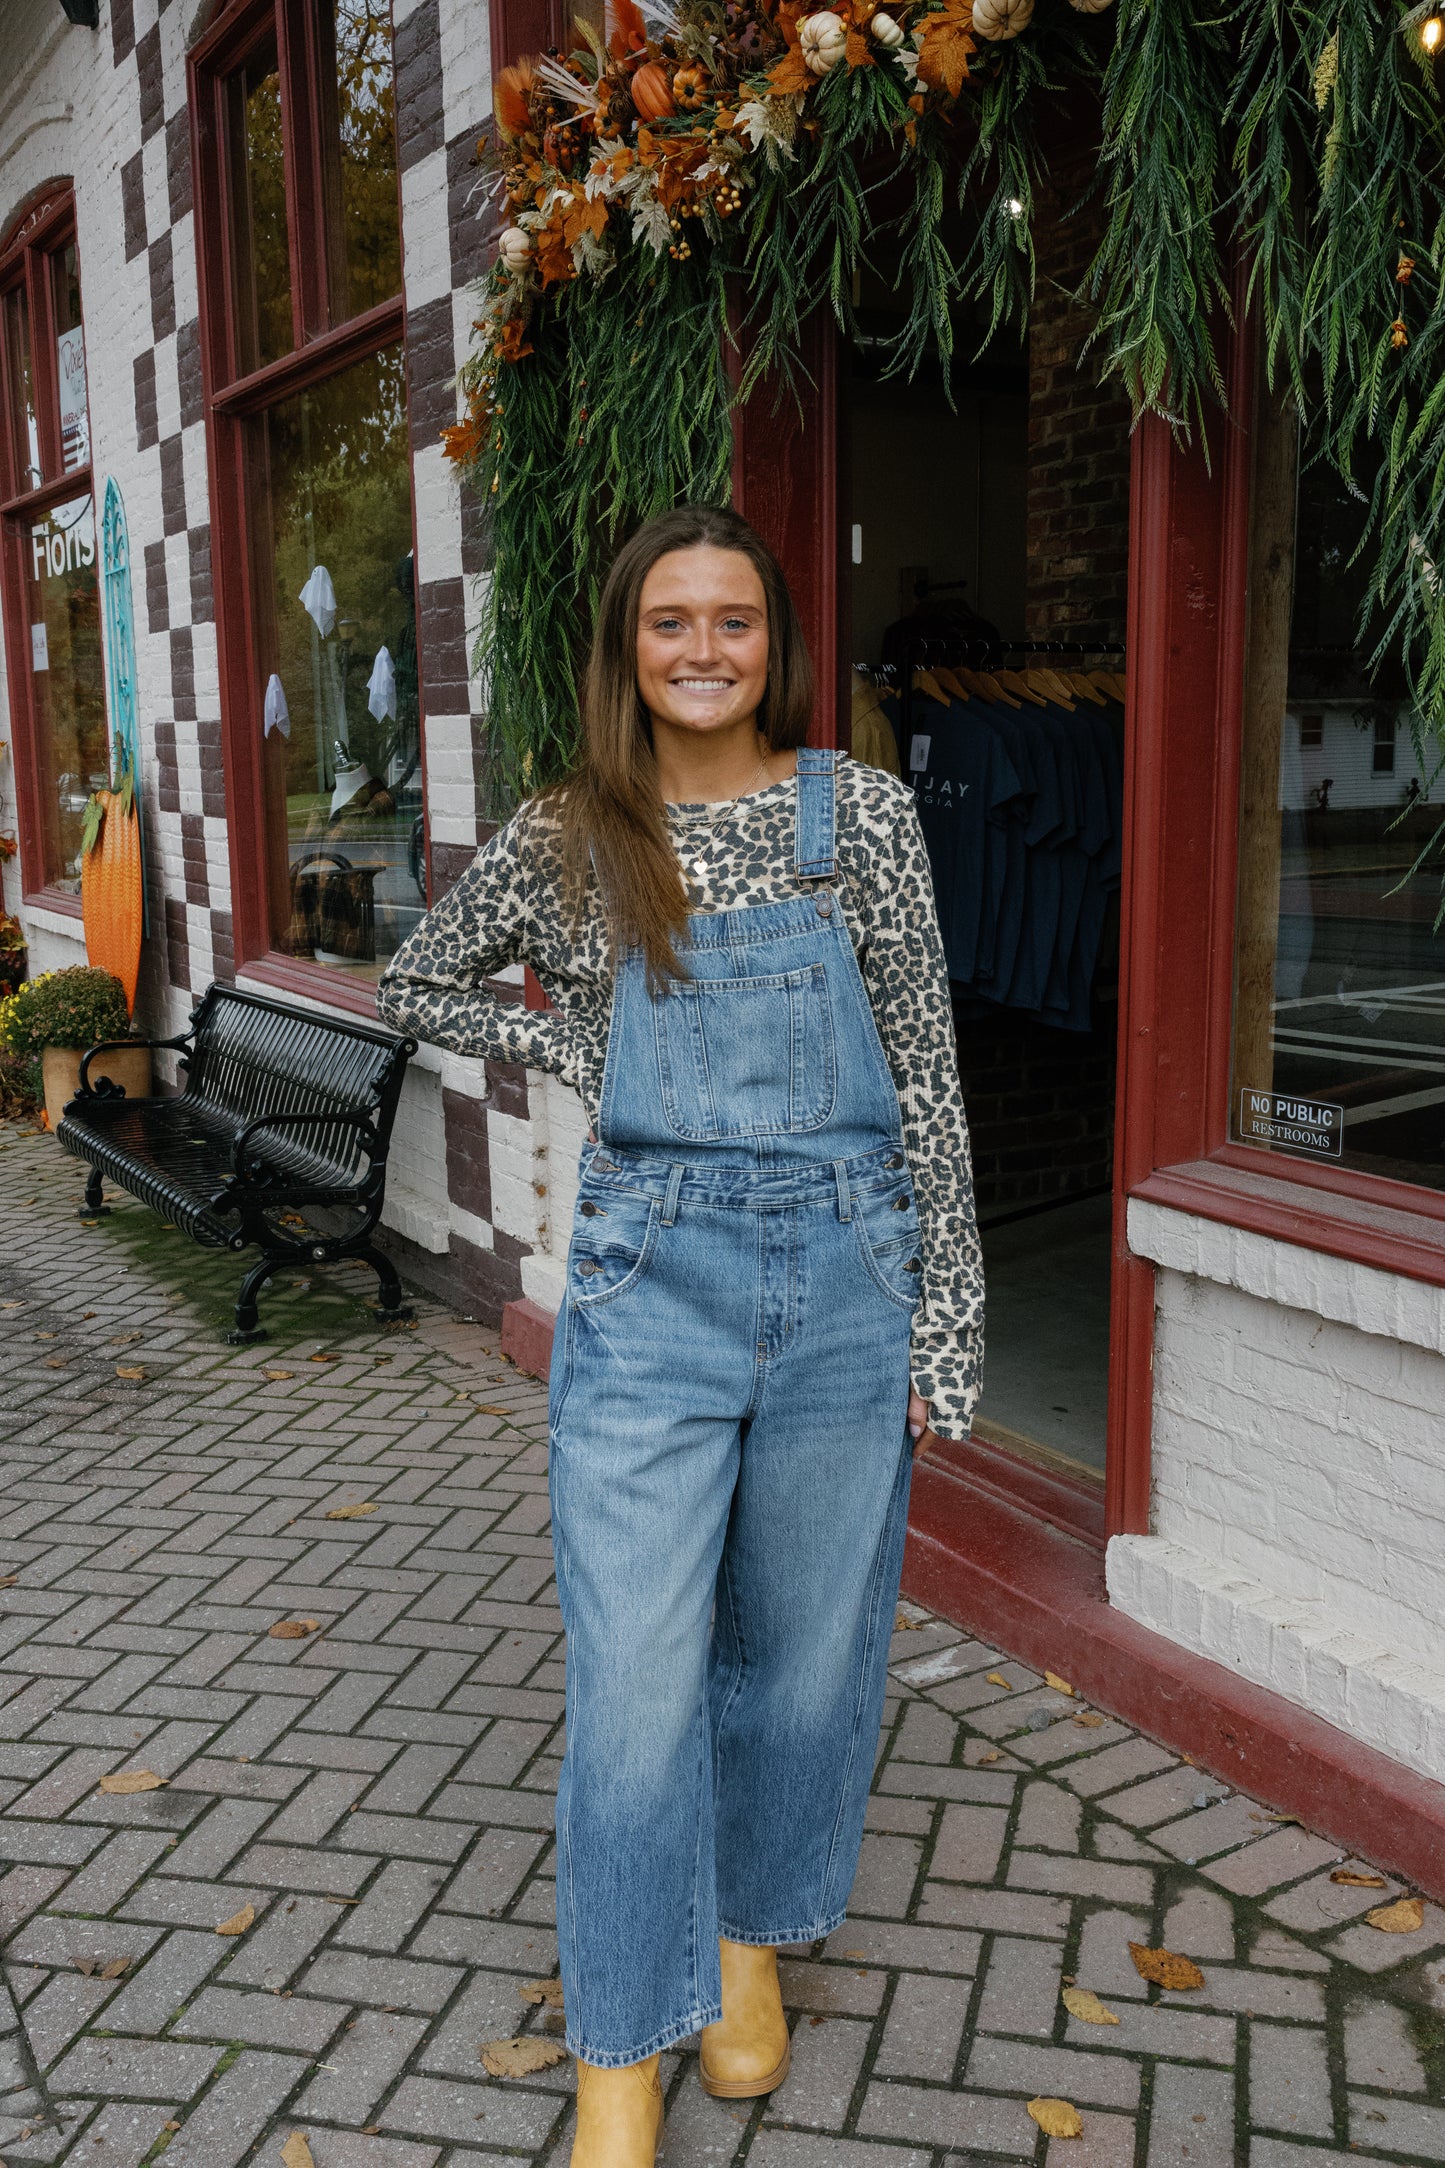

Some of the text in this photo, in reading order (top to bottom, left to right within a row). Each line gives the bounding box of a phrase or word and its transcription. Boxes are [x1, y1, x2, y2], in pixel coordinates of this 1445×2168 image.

[913, 774, 970, 797] IJAY
[912, 792, 952, 808] RGIA
[1250, 1095, 1333, 1127] NO PUBLIC
[1251, 1120, 1330, 1148] RESTROOMS
